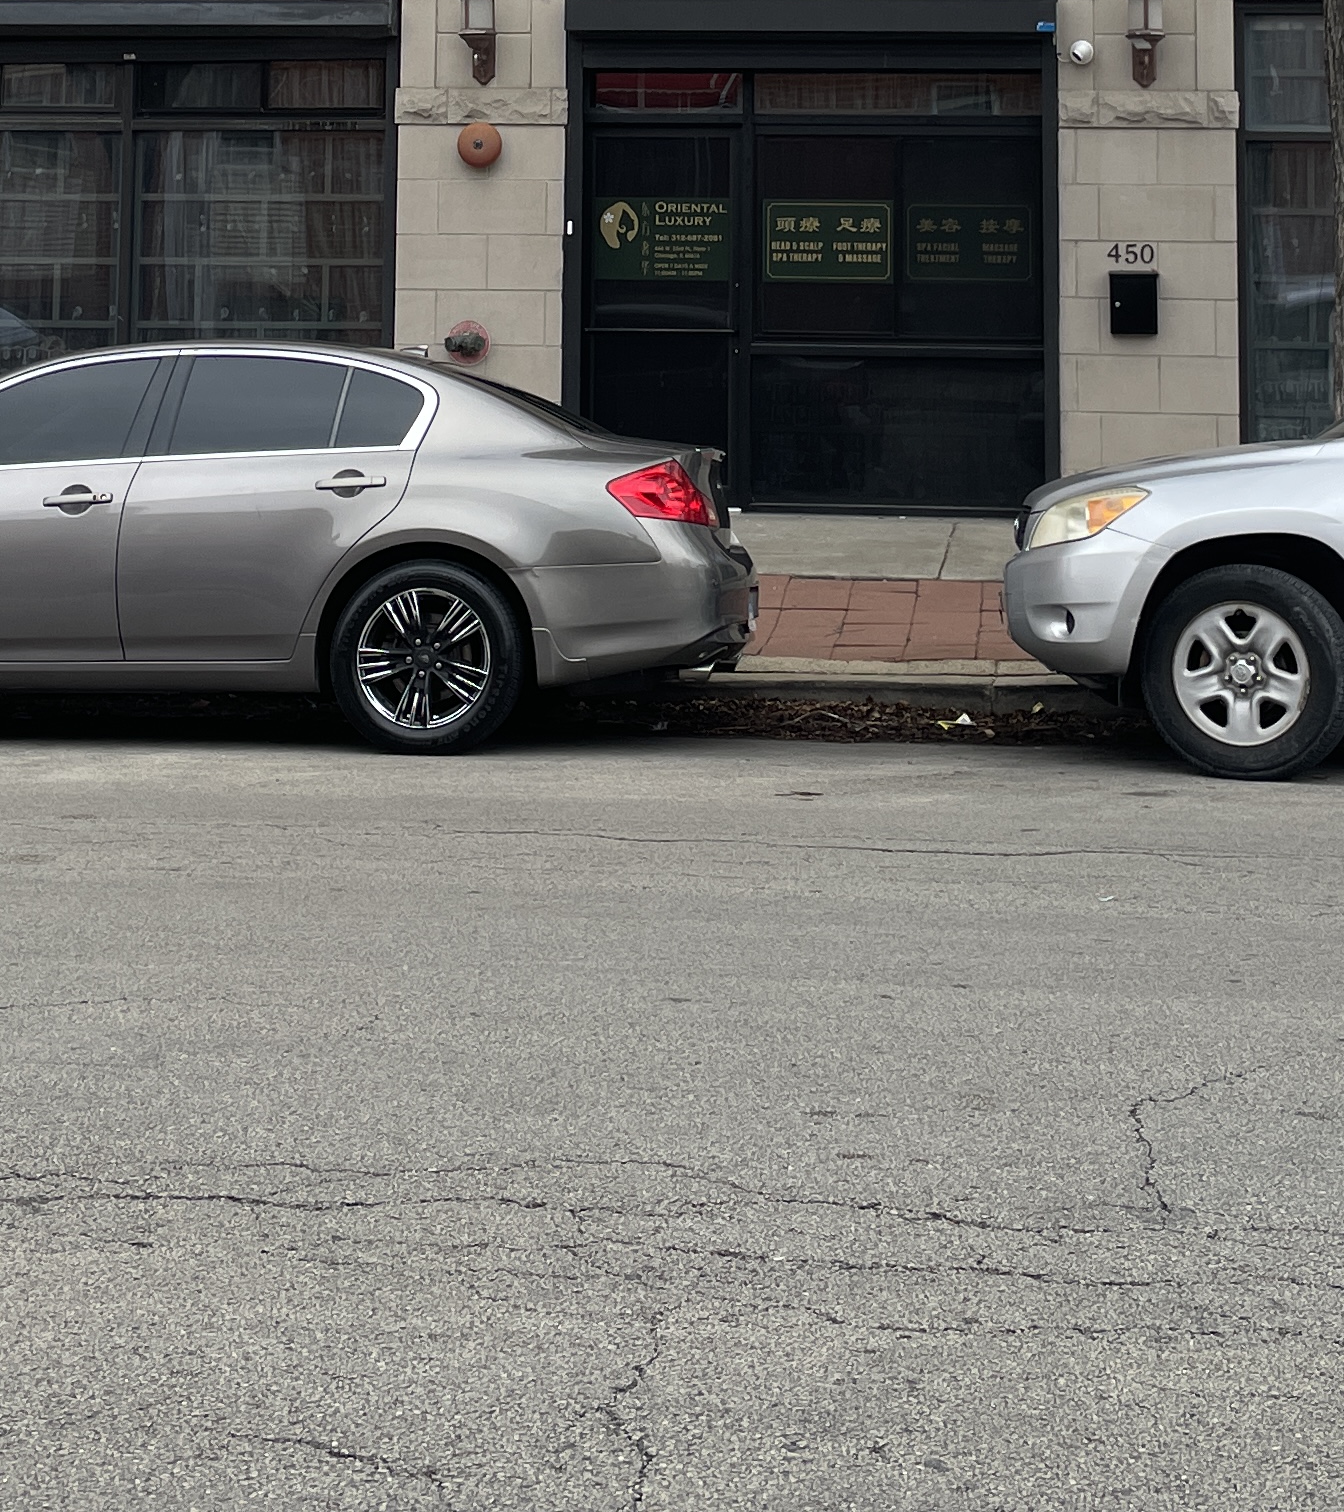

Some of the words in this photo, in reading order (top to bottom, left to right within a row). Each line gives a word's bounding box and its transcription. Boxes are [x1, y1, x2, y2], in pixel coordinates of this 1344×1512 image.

[655, 201, 728, 214] ORIENTAL
[655, 215, 712, 226] LUXURY
[771, 241, 790, 251] HEAD
[799, 241, 824, 251] SCALP
[832, 241, 851, 251] FOOT
[853, 242, 887, 252] THERAPY
[772, 252, 787, 262] SPA
[789, 252, 823, 262] THERAPY
[845, 253, 882, 263] MASSAGE
[1107, 243, 1154, 264] 450
